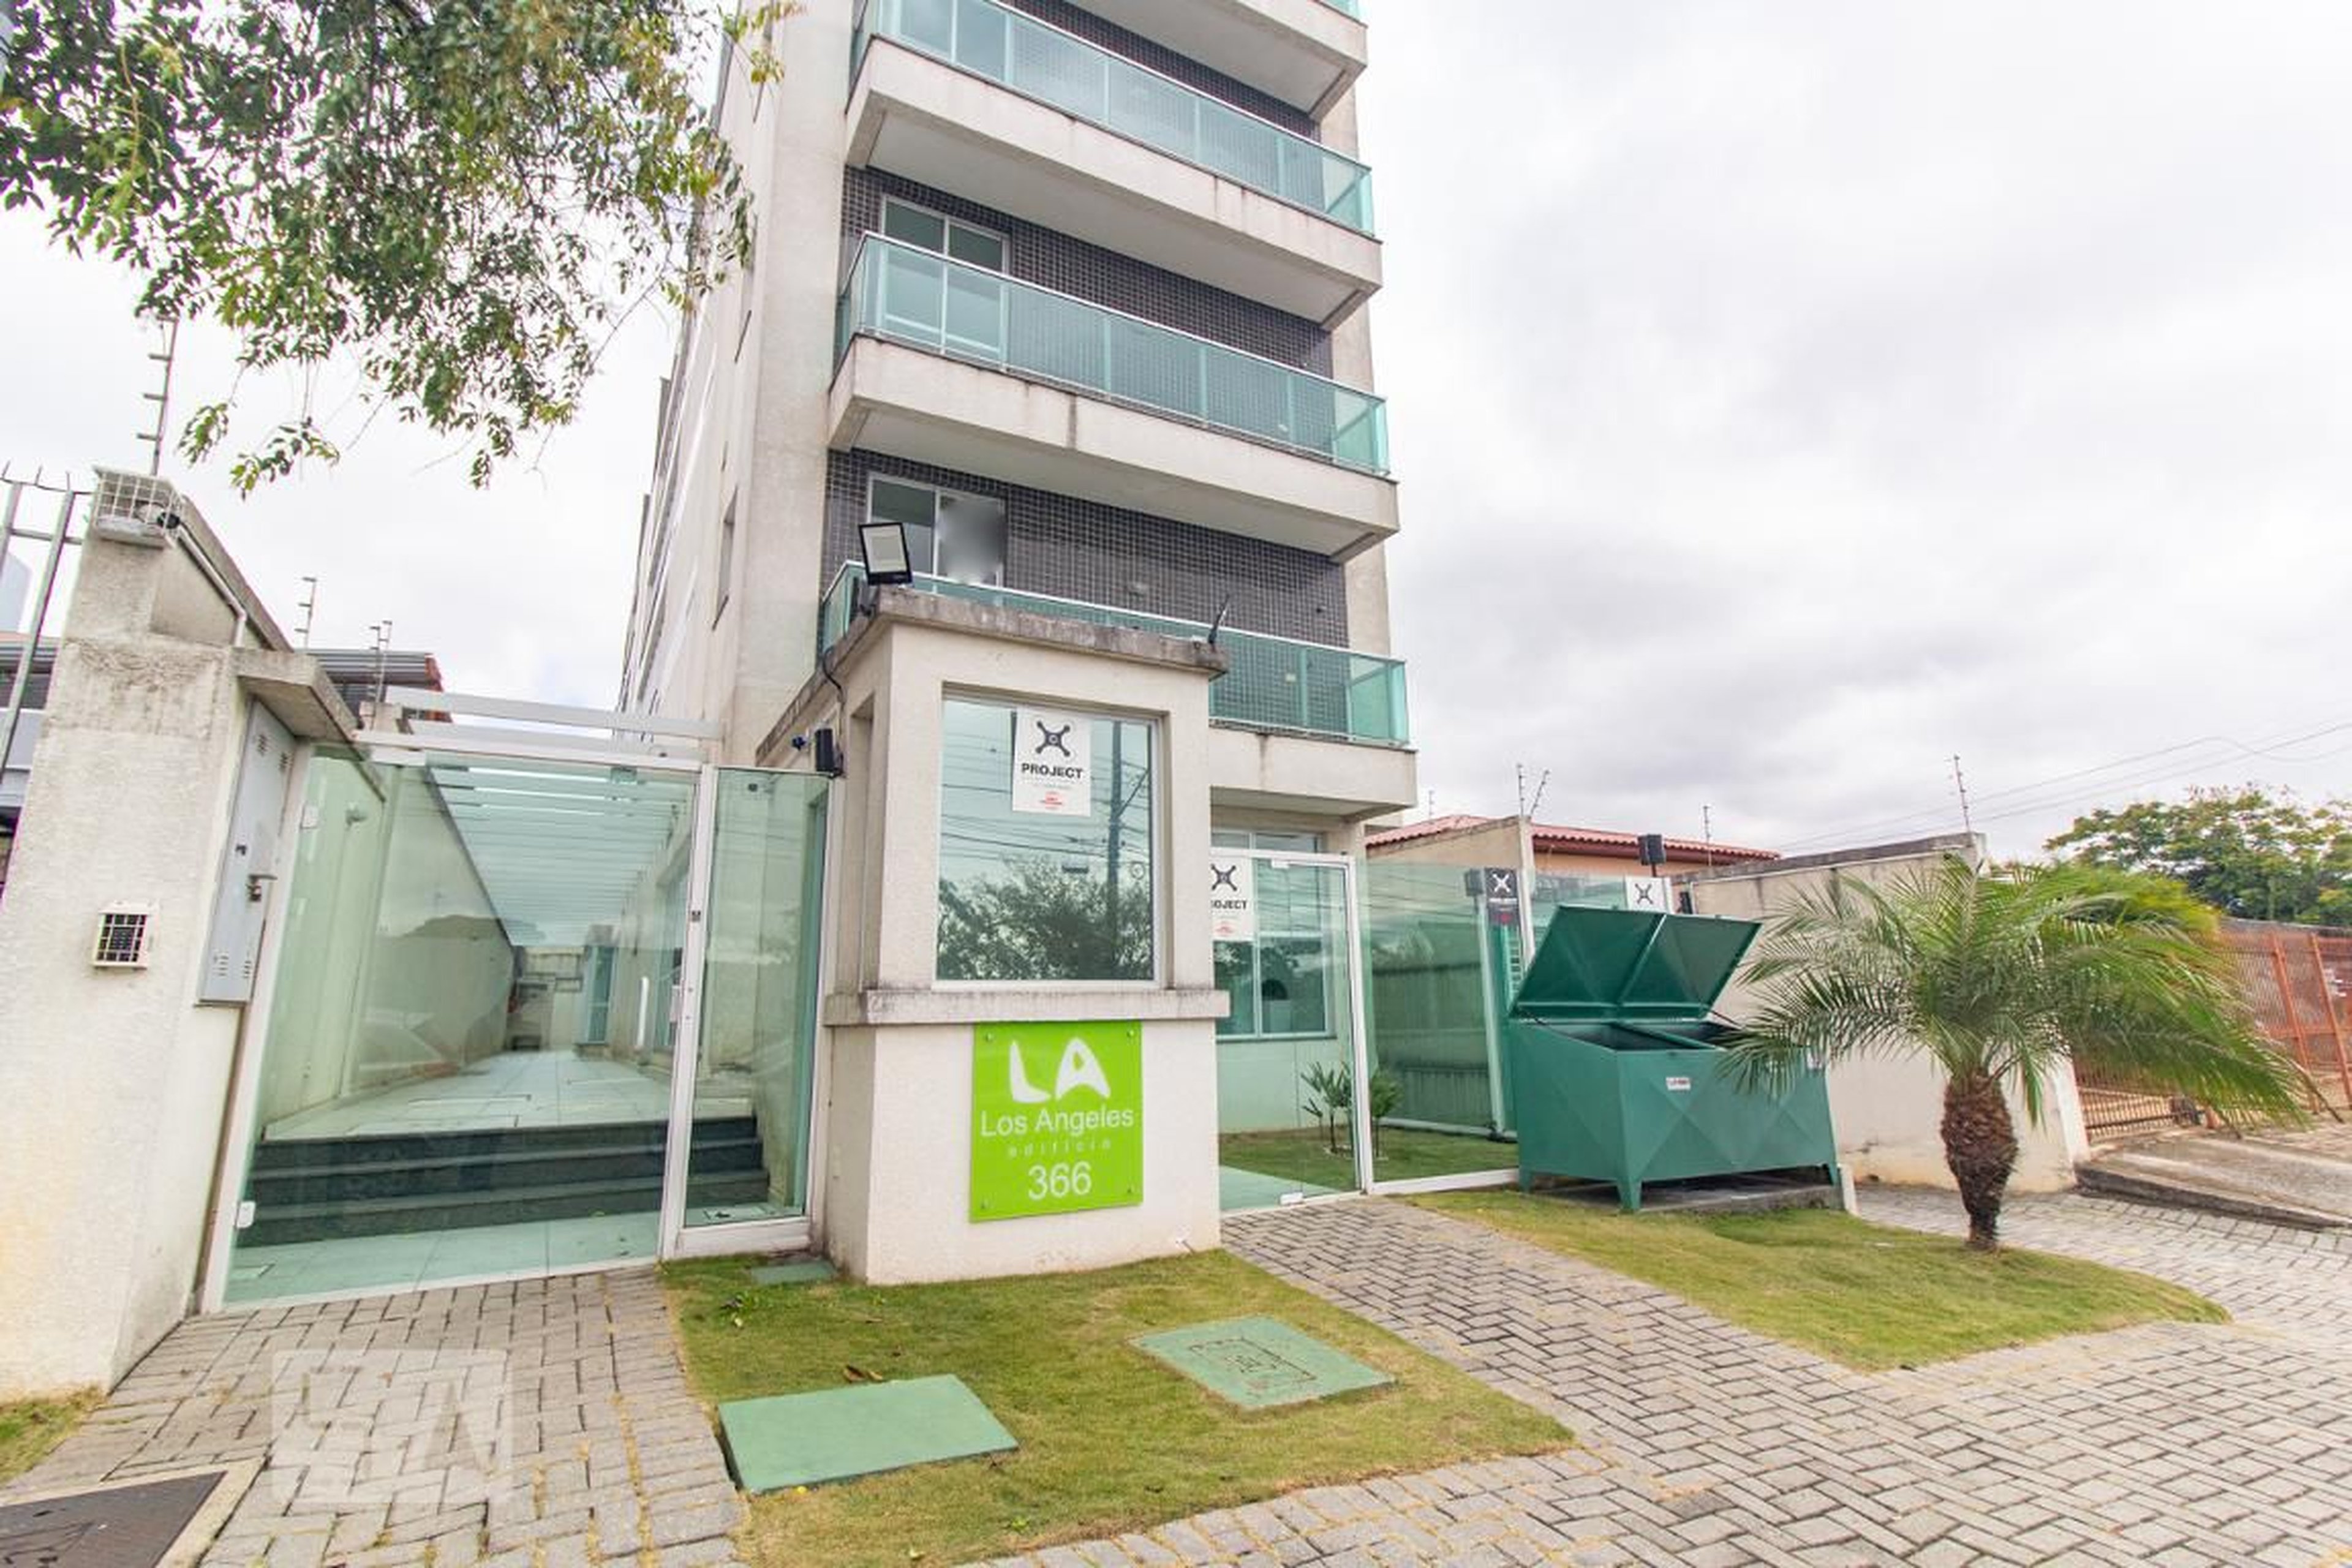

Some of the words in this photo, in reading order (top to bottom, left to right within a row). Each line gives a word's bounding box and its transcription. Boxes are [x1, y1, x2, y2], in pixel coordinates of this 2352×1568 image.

[1021, 763, 1084, 778] PROJECT
[1210, 900, 1247, 910] OJECT
[1009, 1037, 1110, 1103] LA
[981, 1110, 1027, 1137] Los
[1035, 1104, 1133, 1137] Angeles
[1028, 1161, 1092, 1200] 366
